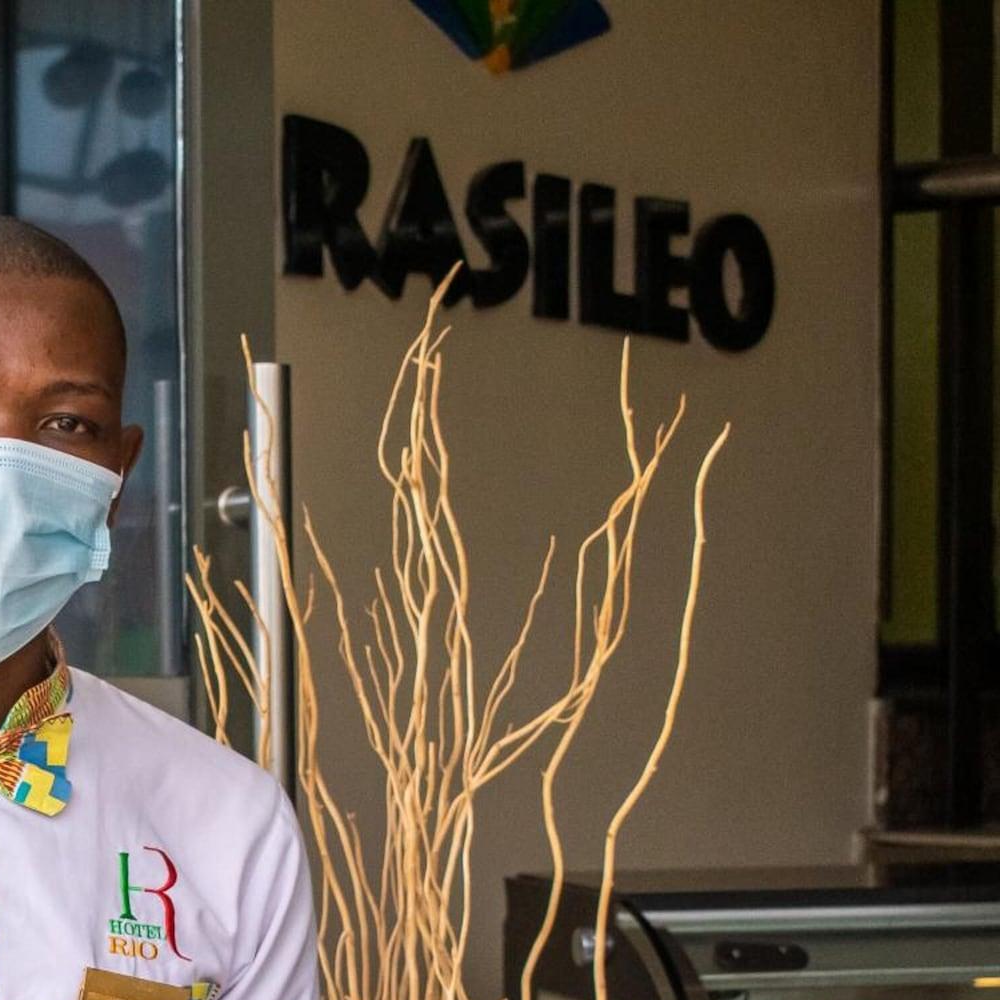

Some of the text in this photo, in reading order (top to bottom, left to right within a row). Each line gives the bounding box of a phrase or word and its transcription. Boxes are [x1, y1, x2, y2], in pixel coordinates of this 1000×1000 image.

[282, 113, 775, 353] RASILEO
[109, 919, 167, 941] HOTEL
[108, 936, 159, 961] RIO
